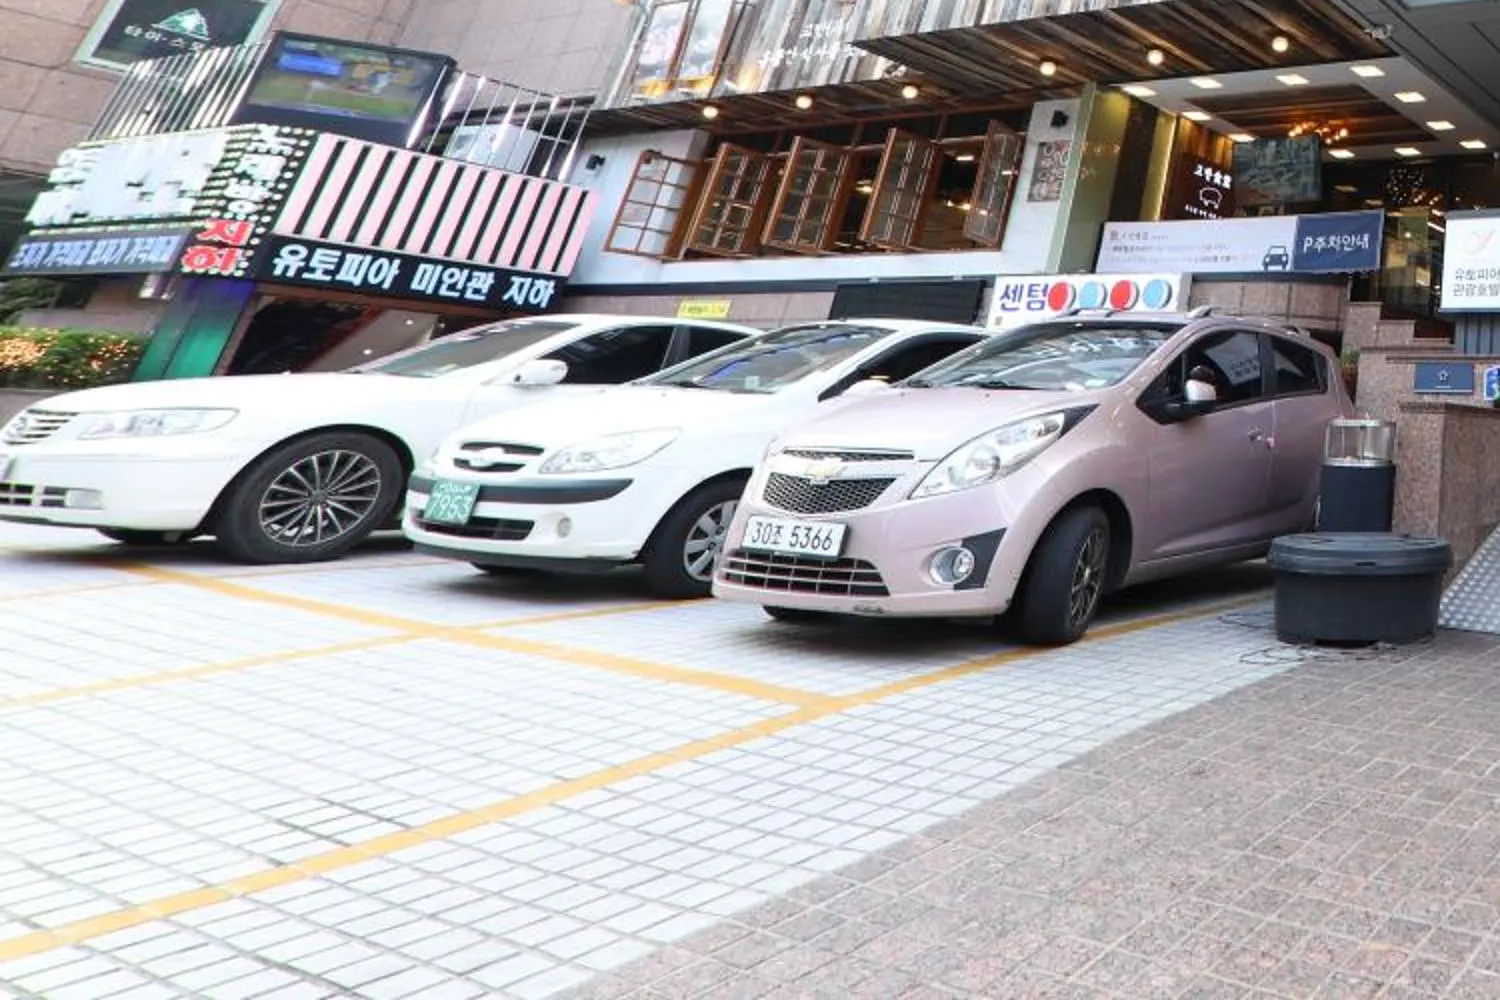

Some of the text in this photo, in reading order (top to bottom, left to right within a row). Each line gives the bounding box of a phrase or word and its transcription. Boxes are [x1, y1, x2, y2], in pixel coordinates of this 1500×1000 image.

[271, 243, 556, 309] 유토피아 미인관 지하
[1455, 267, 1500, 282] 유토피아
[1000, 283, 1049, 313] 센텀
[788, 525, 834, 551] 5366
